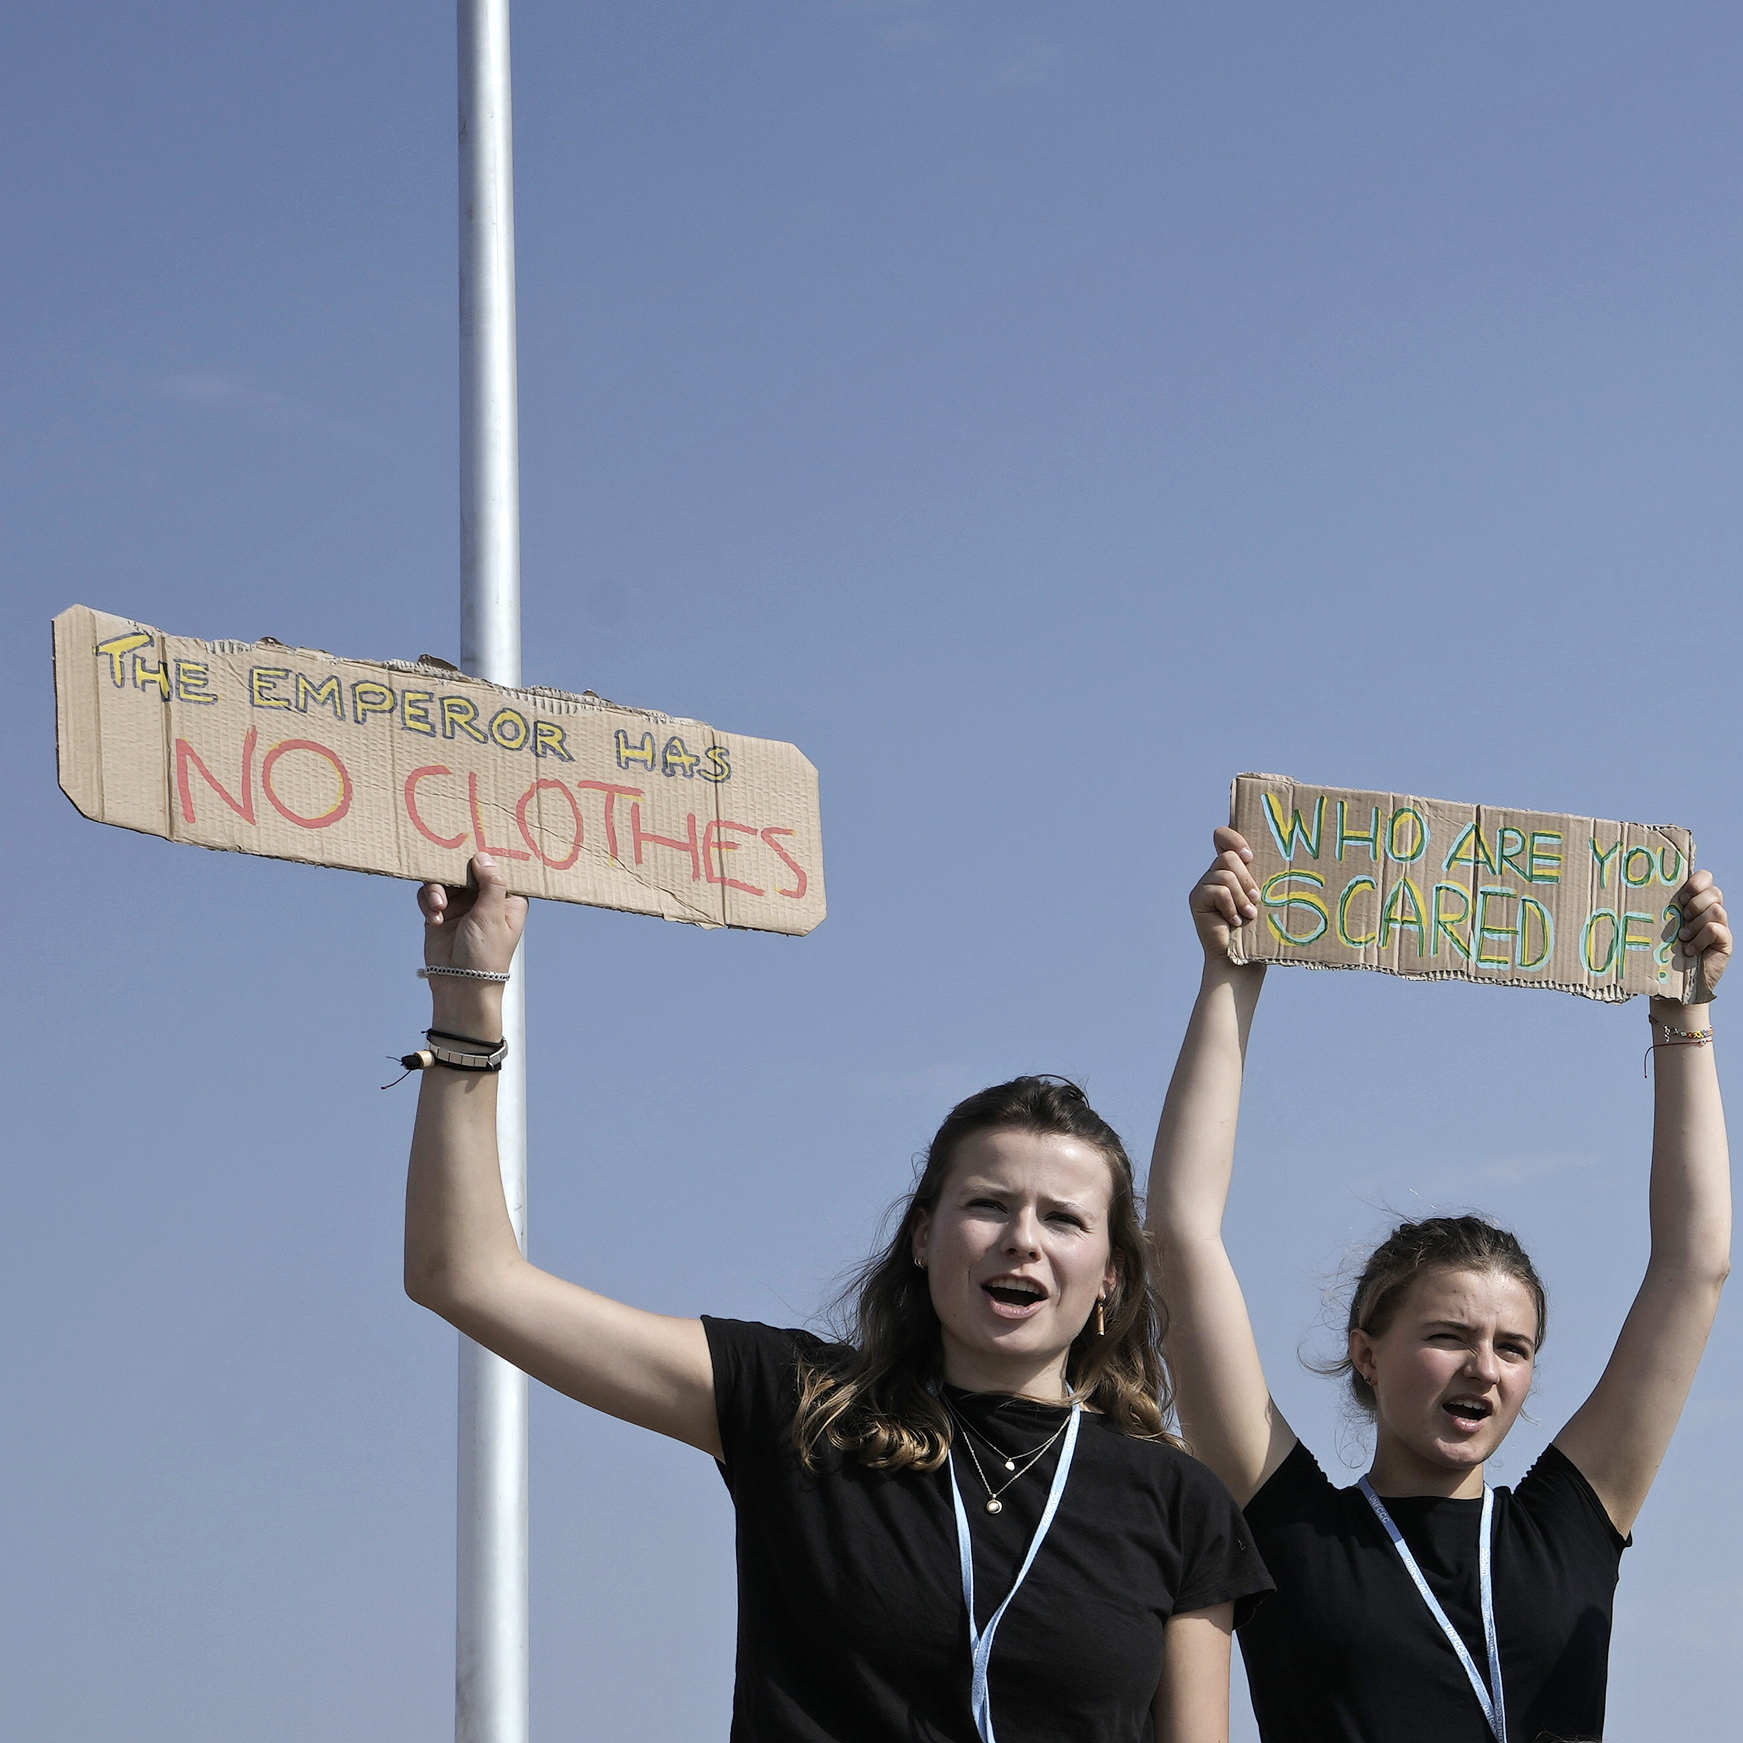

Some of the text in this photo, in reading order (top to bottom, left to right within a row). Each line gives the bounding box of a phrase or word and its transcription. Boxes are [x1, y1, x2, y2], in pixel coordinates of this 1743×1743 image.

[95, 632, 733, 783] THE EMPEROR HAS
[176, 727, 808, 899] NO CLOTHES
[1261, 792, 1684, 889] WHO ARE YOU
[1261, 870, 1554, 972] SCARED
[1369, 1494, 1390, 1524] UNFCCC
[1445, 1623, 1467, 1659] UNFCCC
